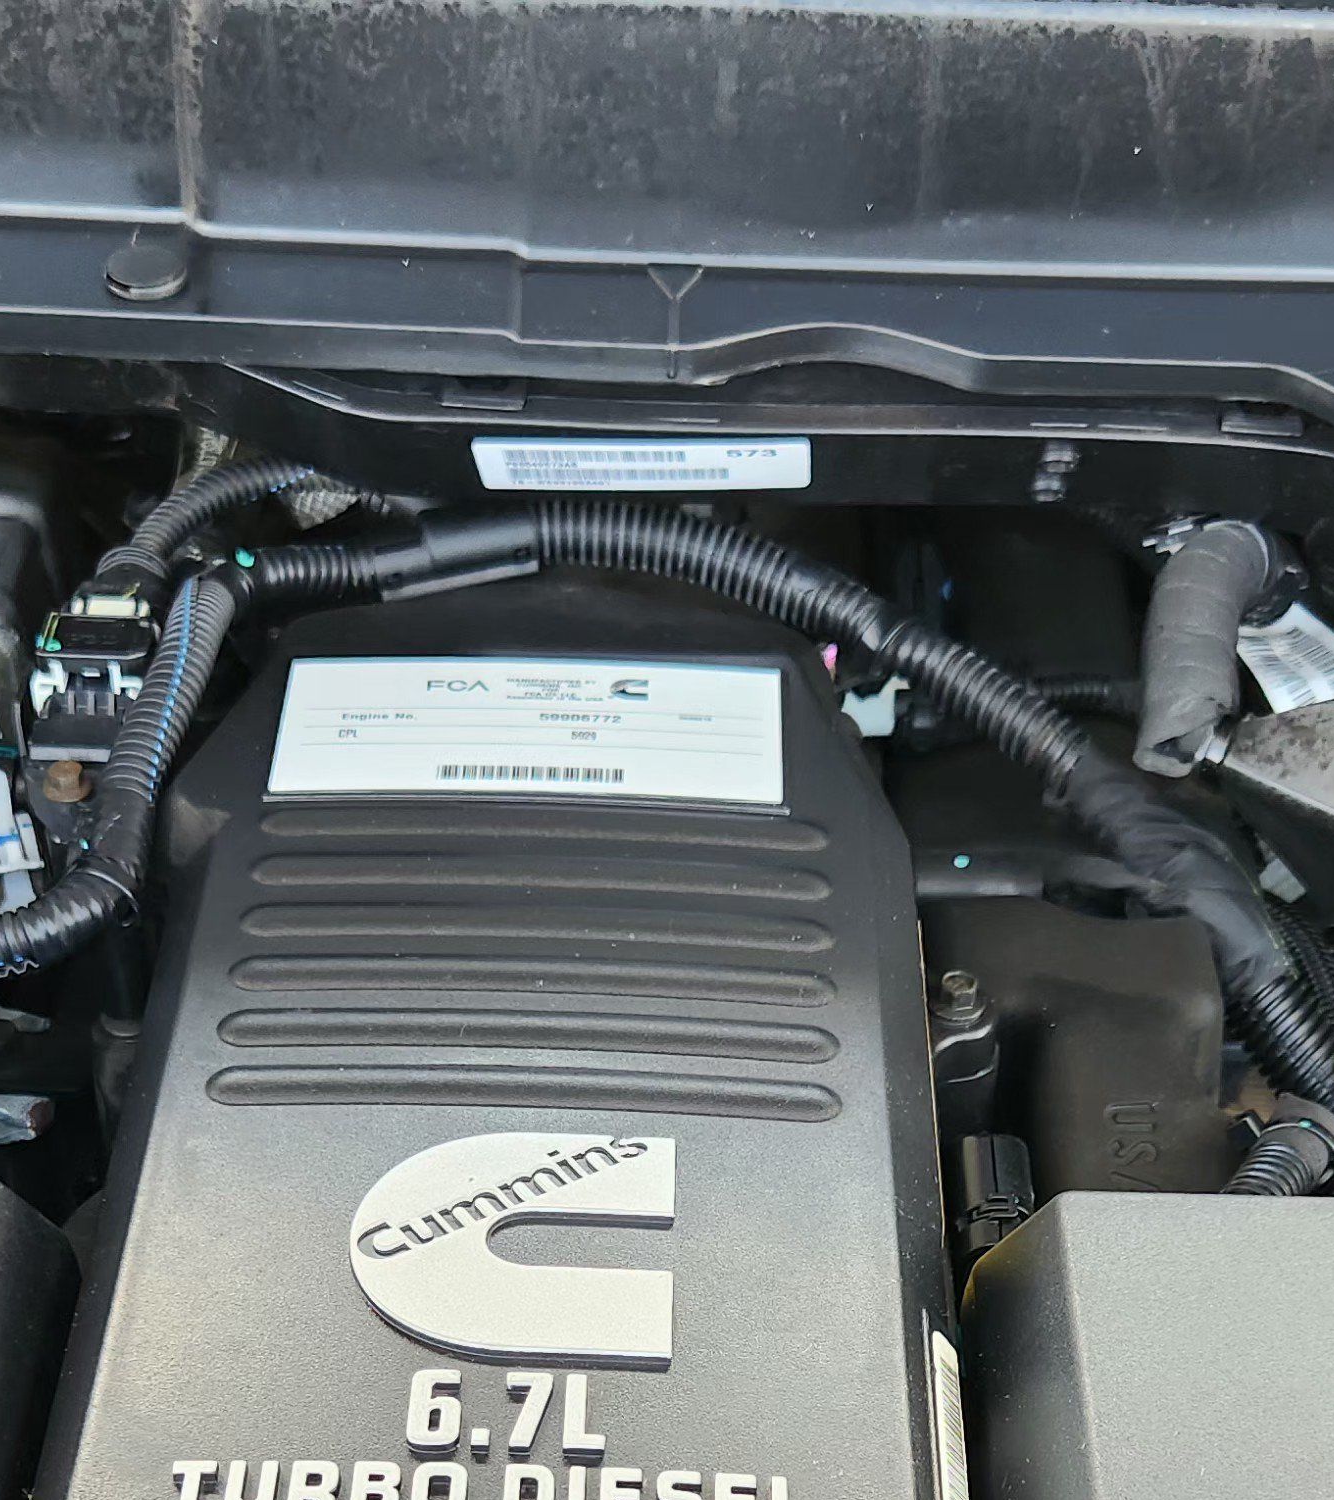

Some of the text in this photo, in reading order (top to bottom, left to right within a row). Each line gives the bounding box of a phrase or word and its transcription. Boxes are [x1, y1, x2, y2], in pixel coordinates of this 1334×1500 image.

[426, 680, 490, 692] FCA
[342, 712, 389, 722] Engine
[338, 729, 358, 738] CPL
[357, 1135, 649, 1260] Cummins
[406, 1369, 607, 1458] 6.7L
